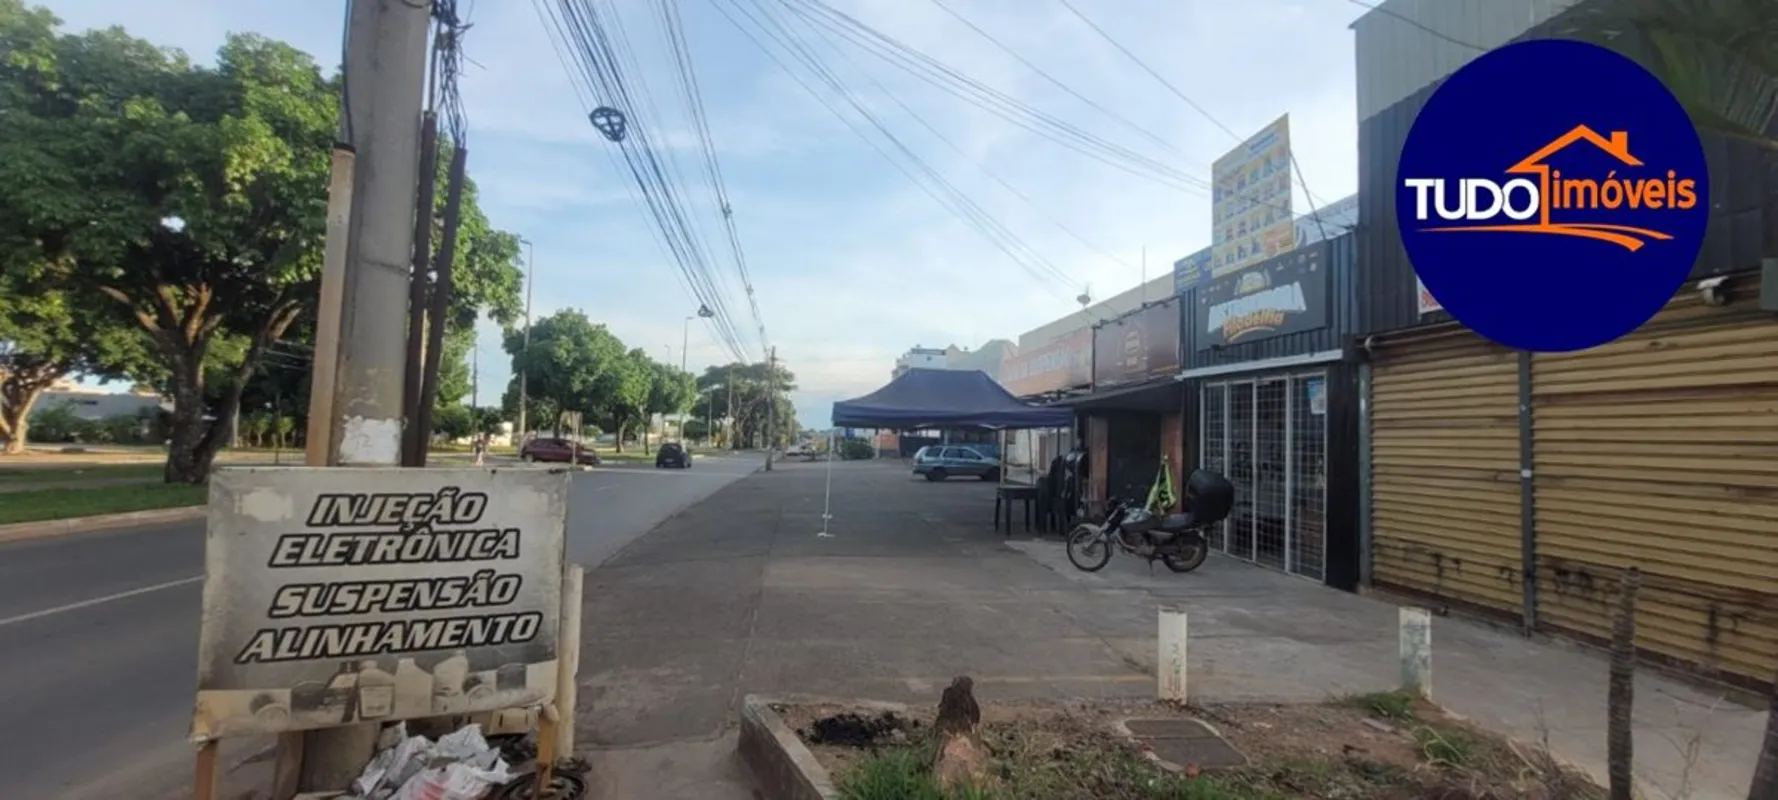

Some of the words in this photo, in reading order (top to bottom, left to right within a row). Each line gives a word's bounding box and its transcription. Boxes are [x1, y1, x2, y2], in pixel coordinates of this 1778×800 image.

[307, 487, 489, 531] INJEÇÃO
[268, 526, 521, 568] ELETRÔNICA
[268, 570, 523, 619] SUSPENSÃO
[235, 611, 544, 665] ALINHAMENTO
